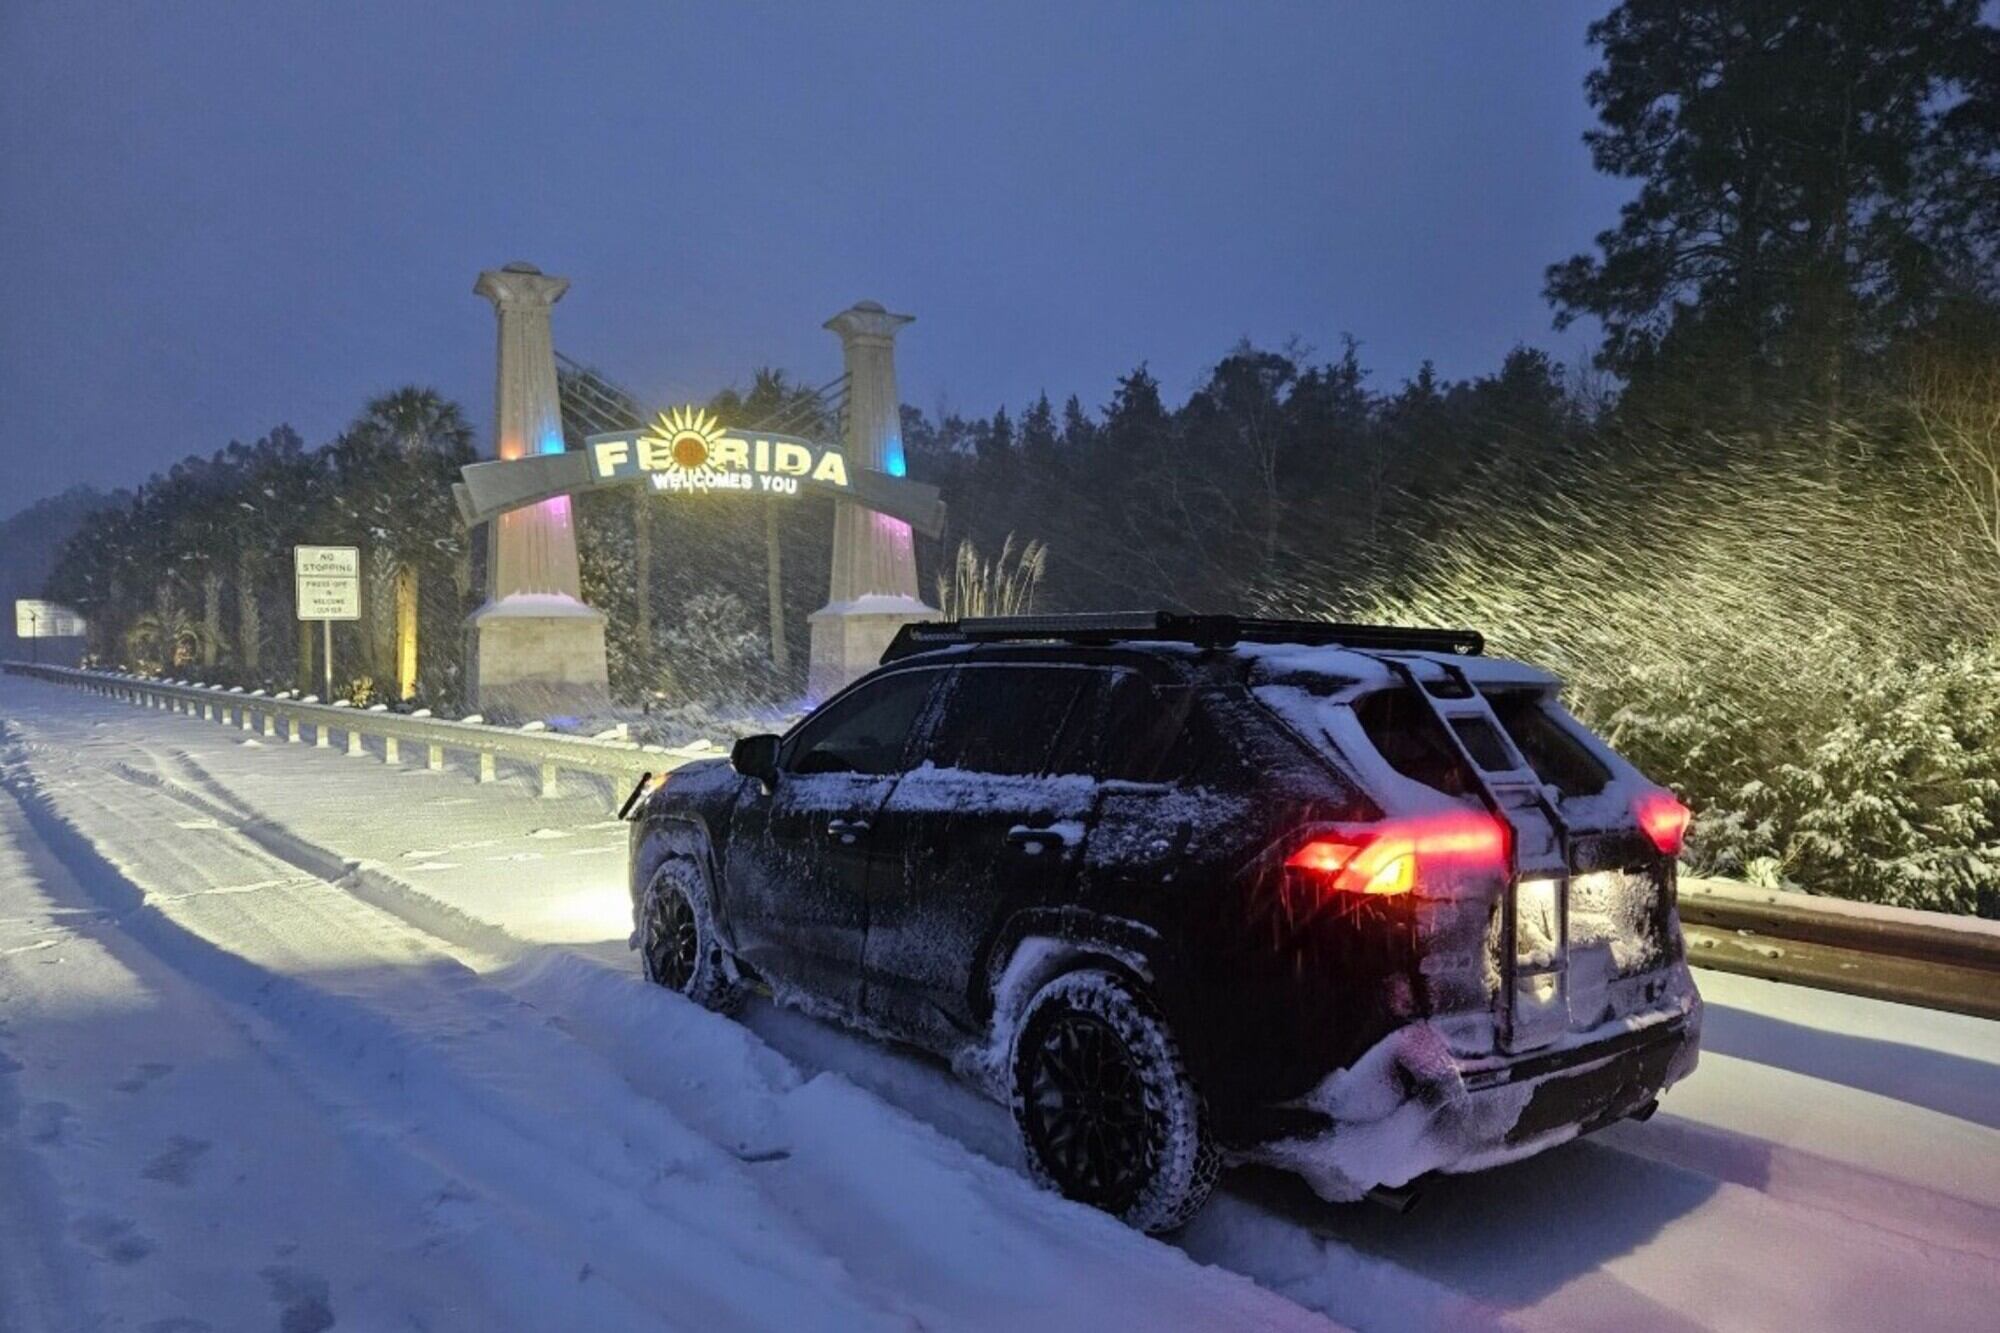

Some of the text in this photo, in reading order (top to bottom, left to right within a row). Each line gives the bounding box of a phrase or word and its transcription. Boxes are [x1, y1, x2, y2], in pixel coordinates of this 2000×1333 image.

[651, 472, 798, 494] WELCOMES YOU
[320, 553, 334, 561] NO
[303, 563, 353, 572] STOPPING
